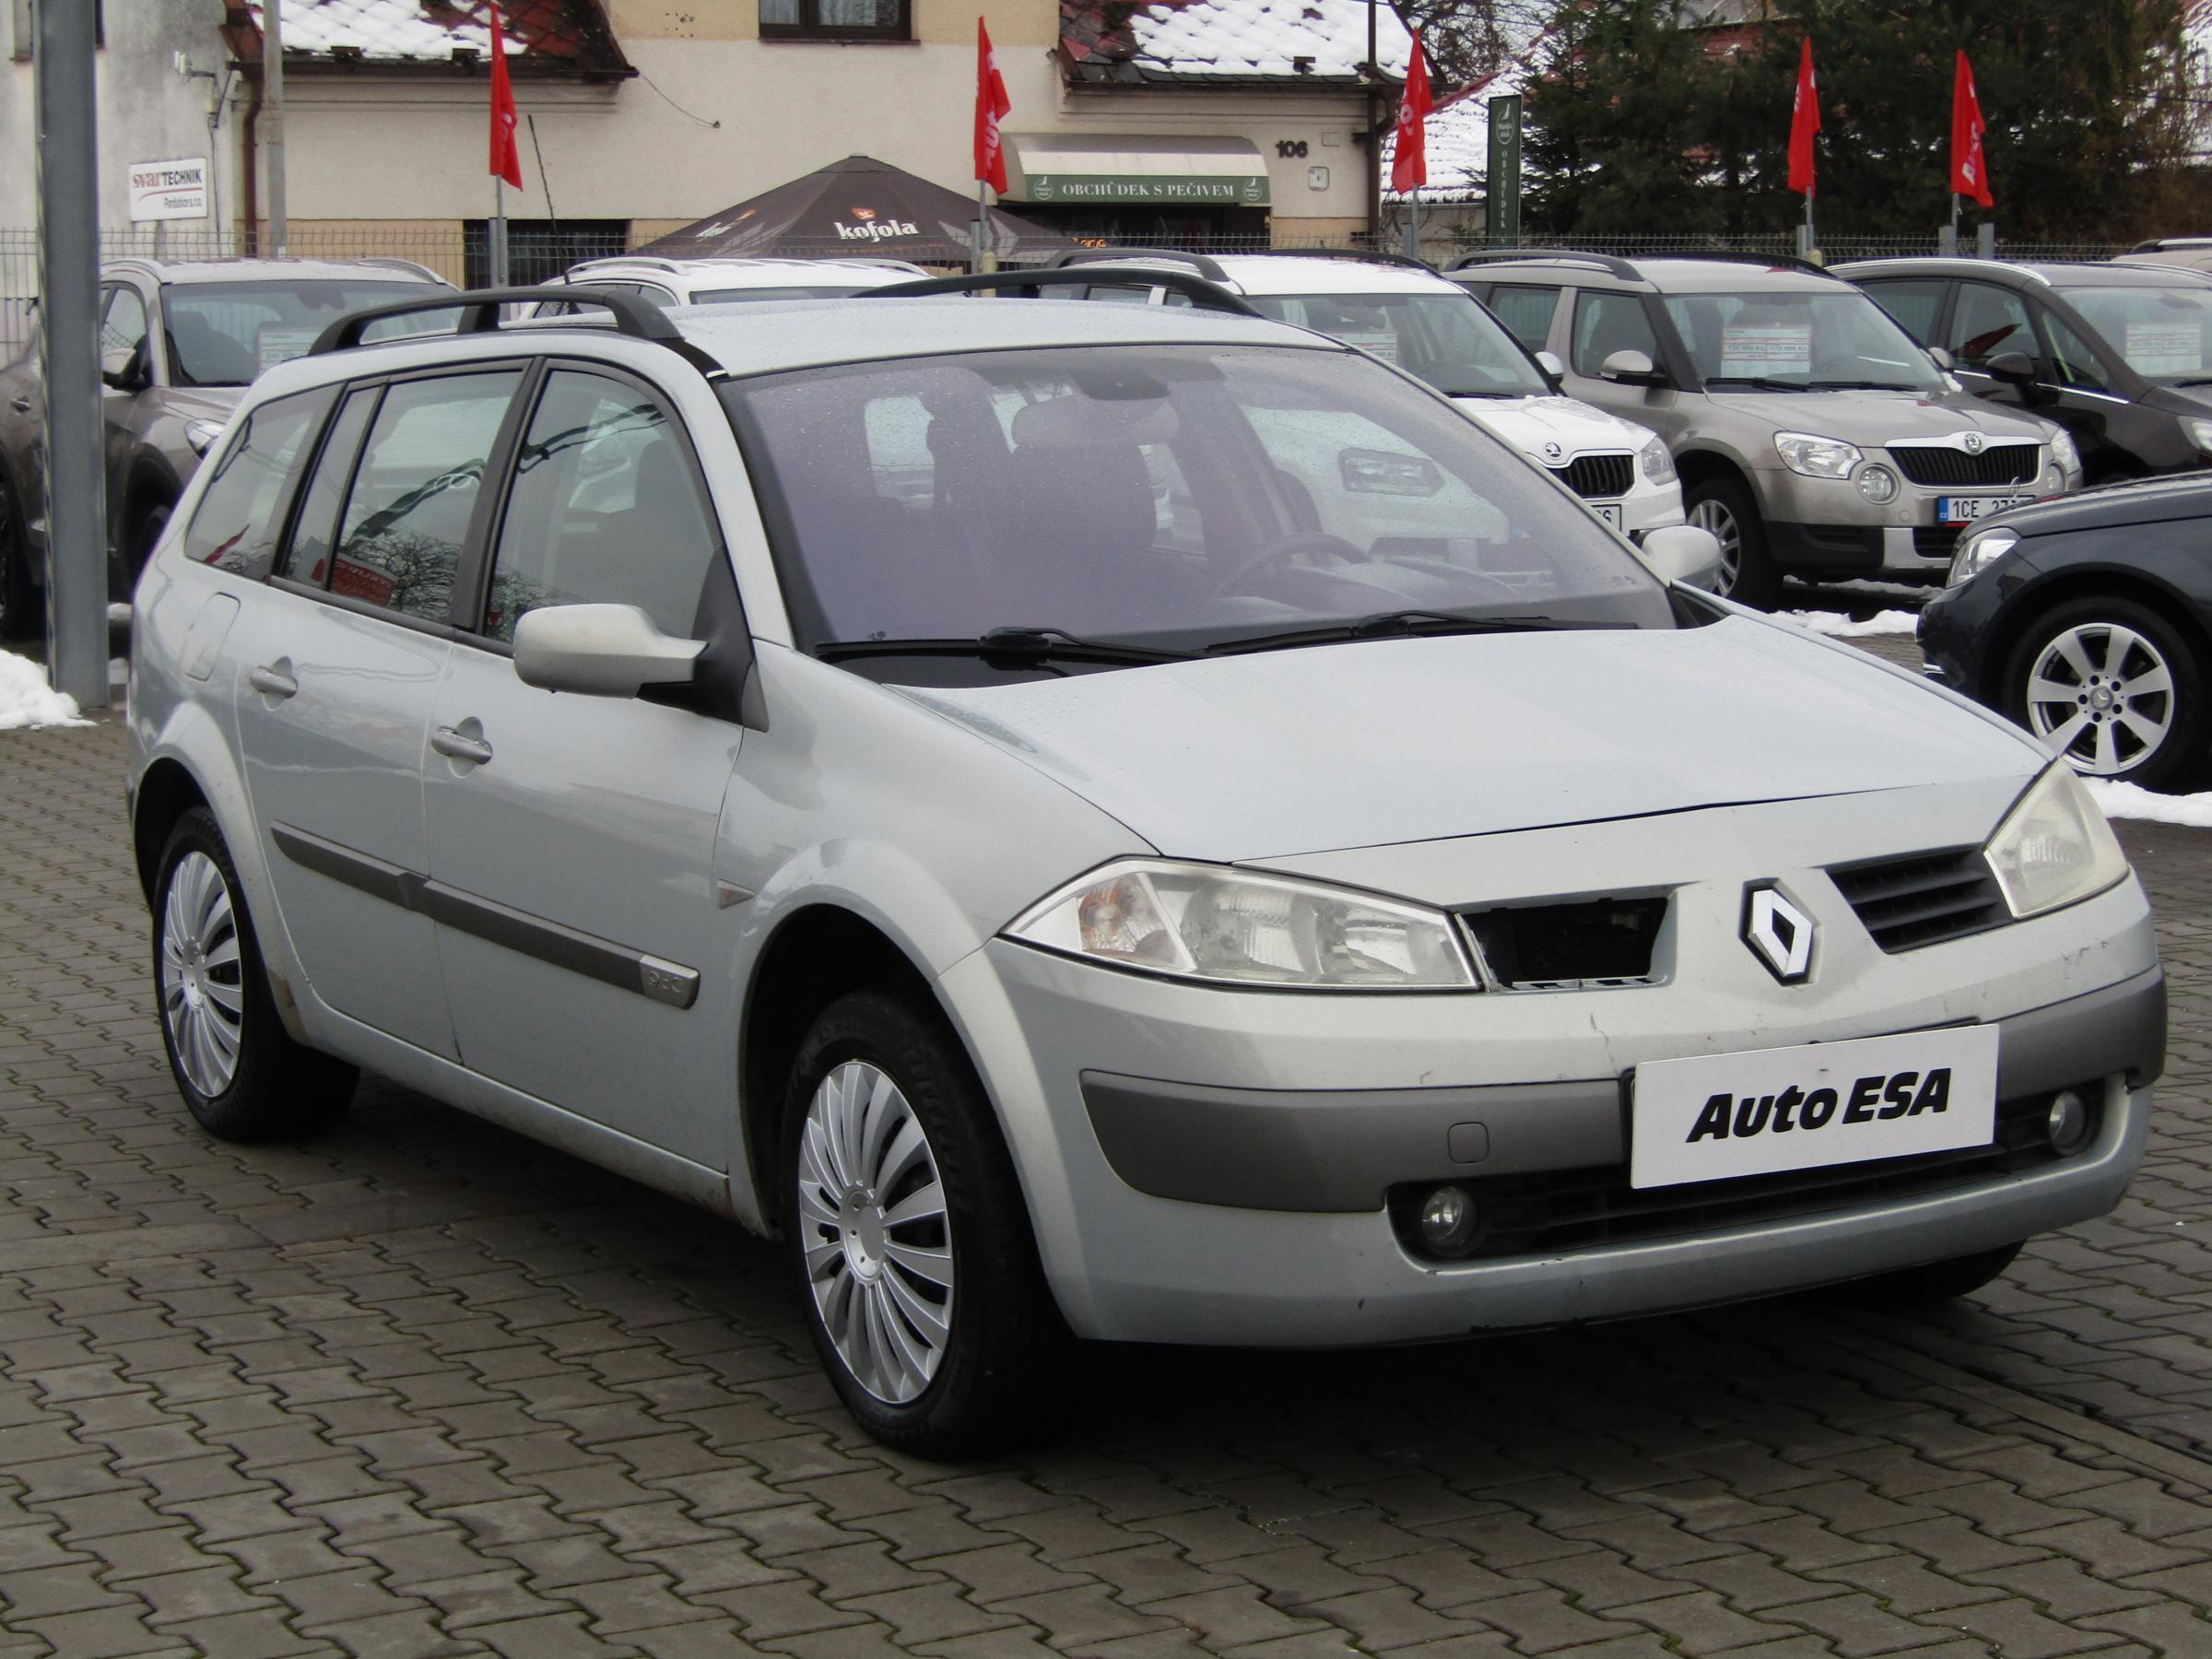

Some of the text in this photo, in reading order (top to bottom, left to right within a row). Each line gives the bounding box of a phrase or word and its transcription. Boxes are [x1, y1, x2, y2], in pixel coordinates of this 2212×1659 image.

[1276, 140, 1308, 158] 106
[1063, 182, 1149, 195] OBCHŮDEK
[1153, 184, 1162, 195] S
[1167, 182, 1234, 195] PEČIVEM
[833, 219, 919, 242] kofola
[1953, 500, 1980, 518] 1CE
[1685, 1067, 1951, 1143] Auto ESA
